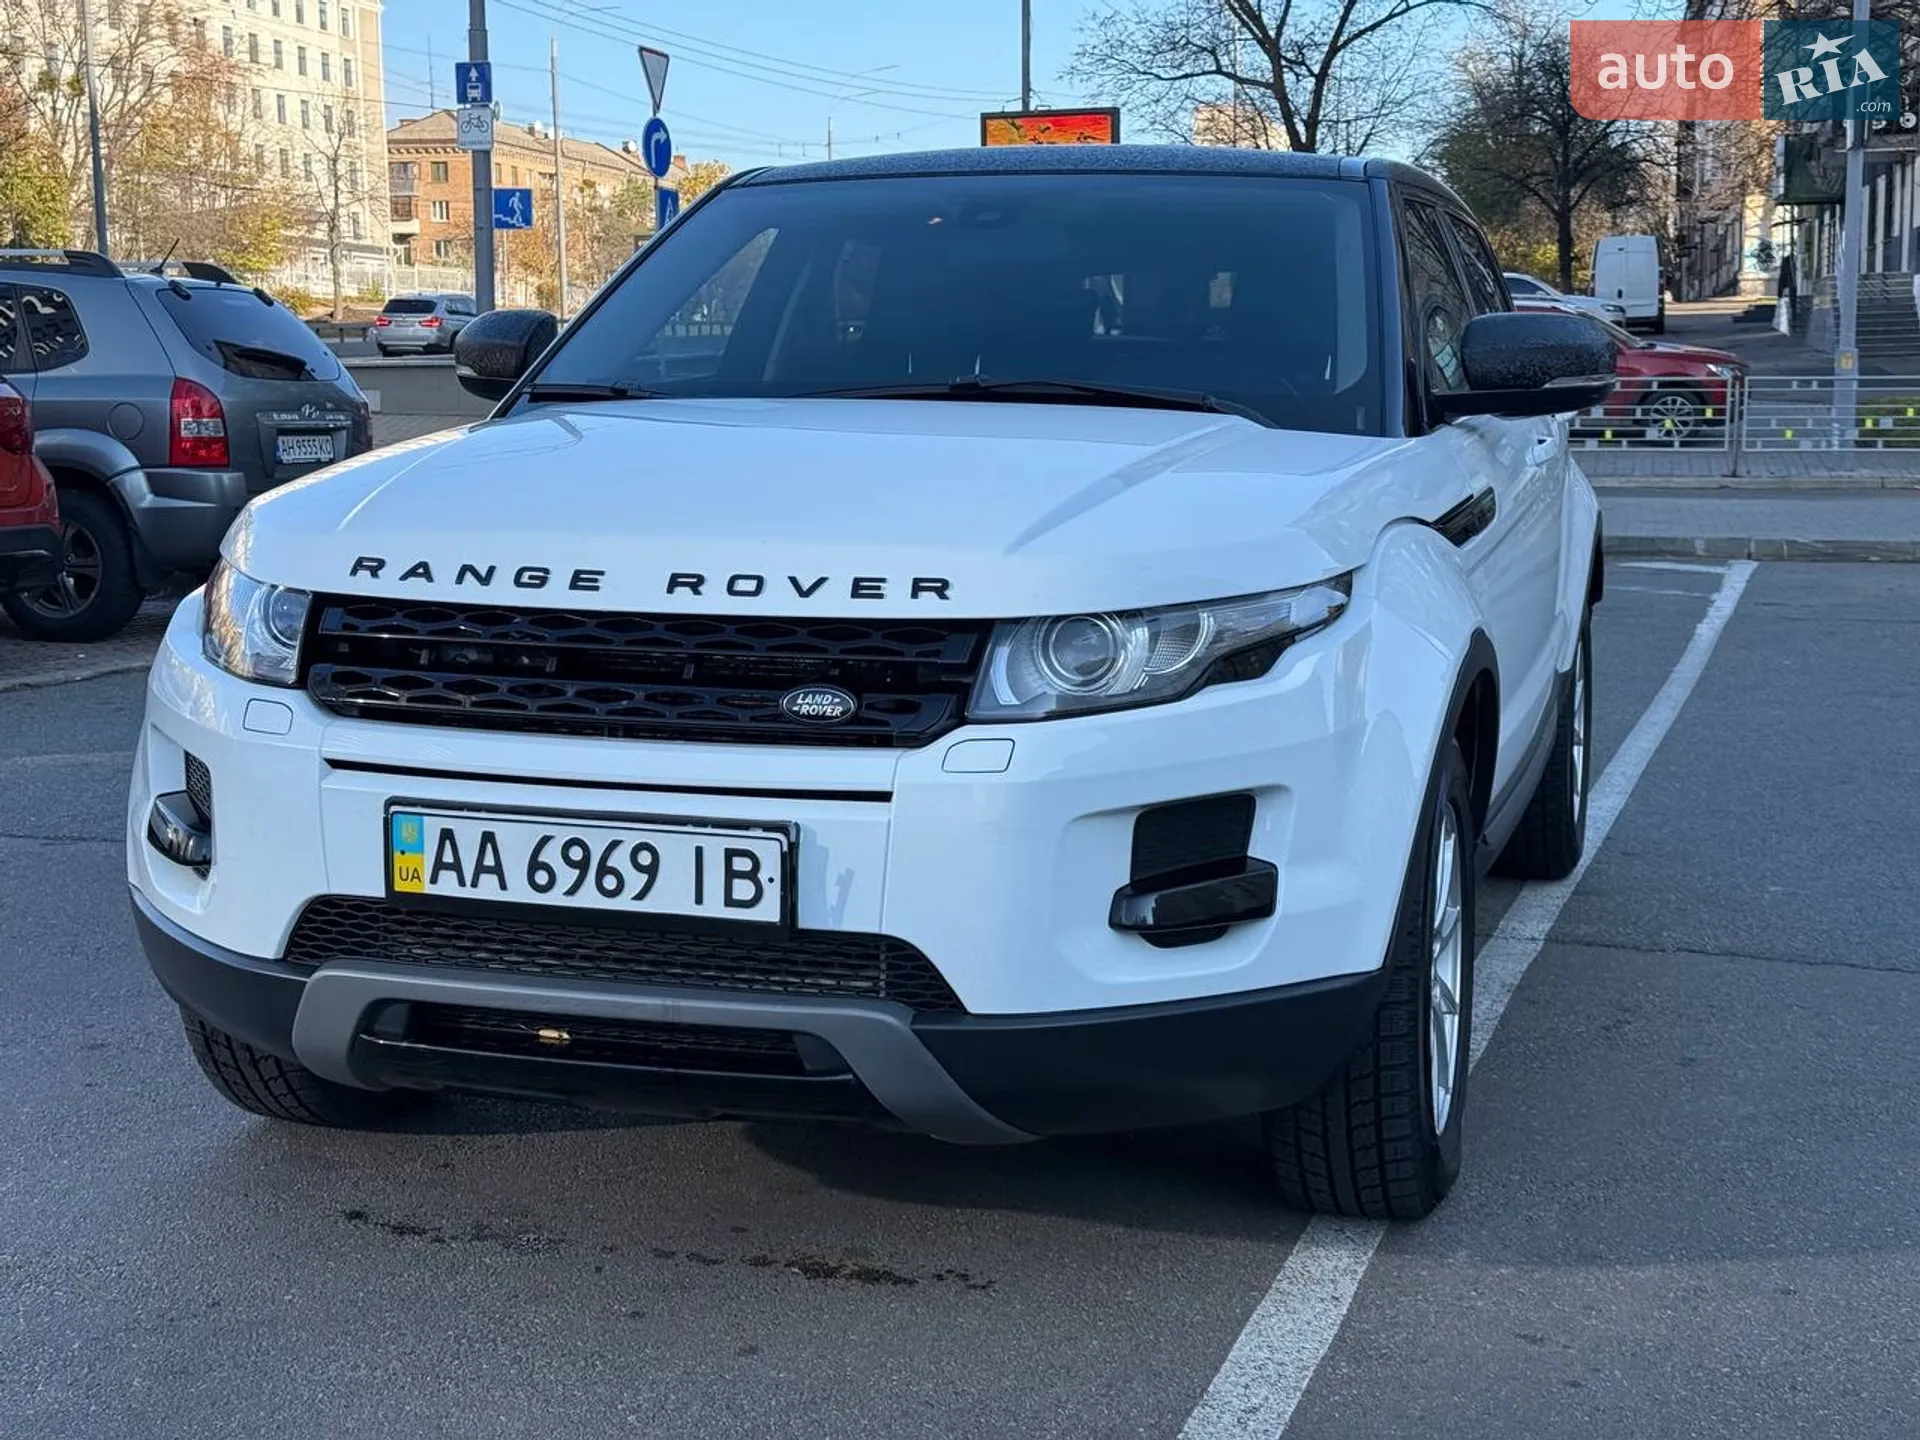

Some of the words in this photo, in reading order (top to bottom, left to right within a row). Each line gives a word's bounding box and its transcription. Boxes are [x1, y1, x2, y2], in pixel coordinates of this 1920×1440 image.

[349, 556, 606, 592] RANGE
[666, 572, 951, 600] ROVER
[796, 693, 832, 705] LAND
[799, 704, 843, 717] ROVER
[399, 866, 422, 884] UA
[429, 827, 509, 891] AA
[526, 834, 661, 902] 6969
[694, 845, 764, 909] IB
